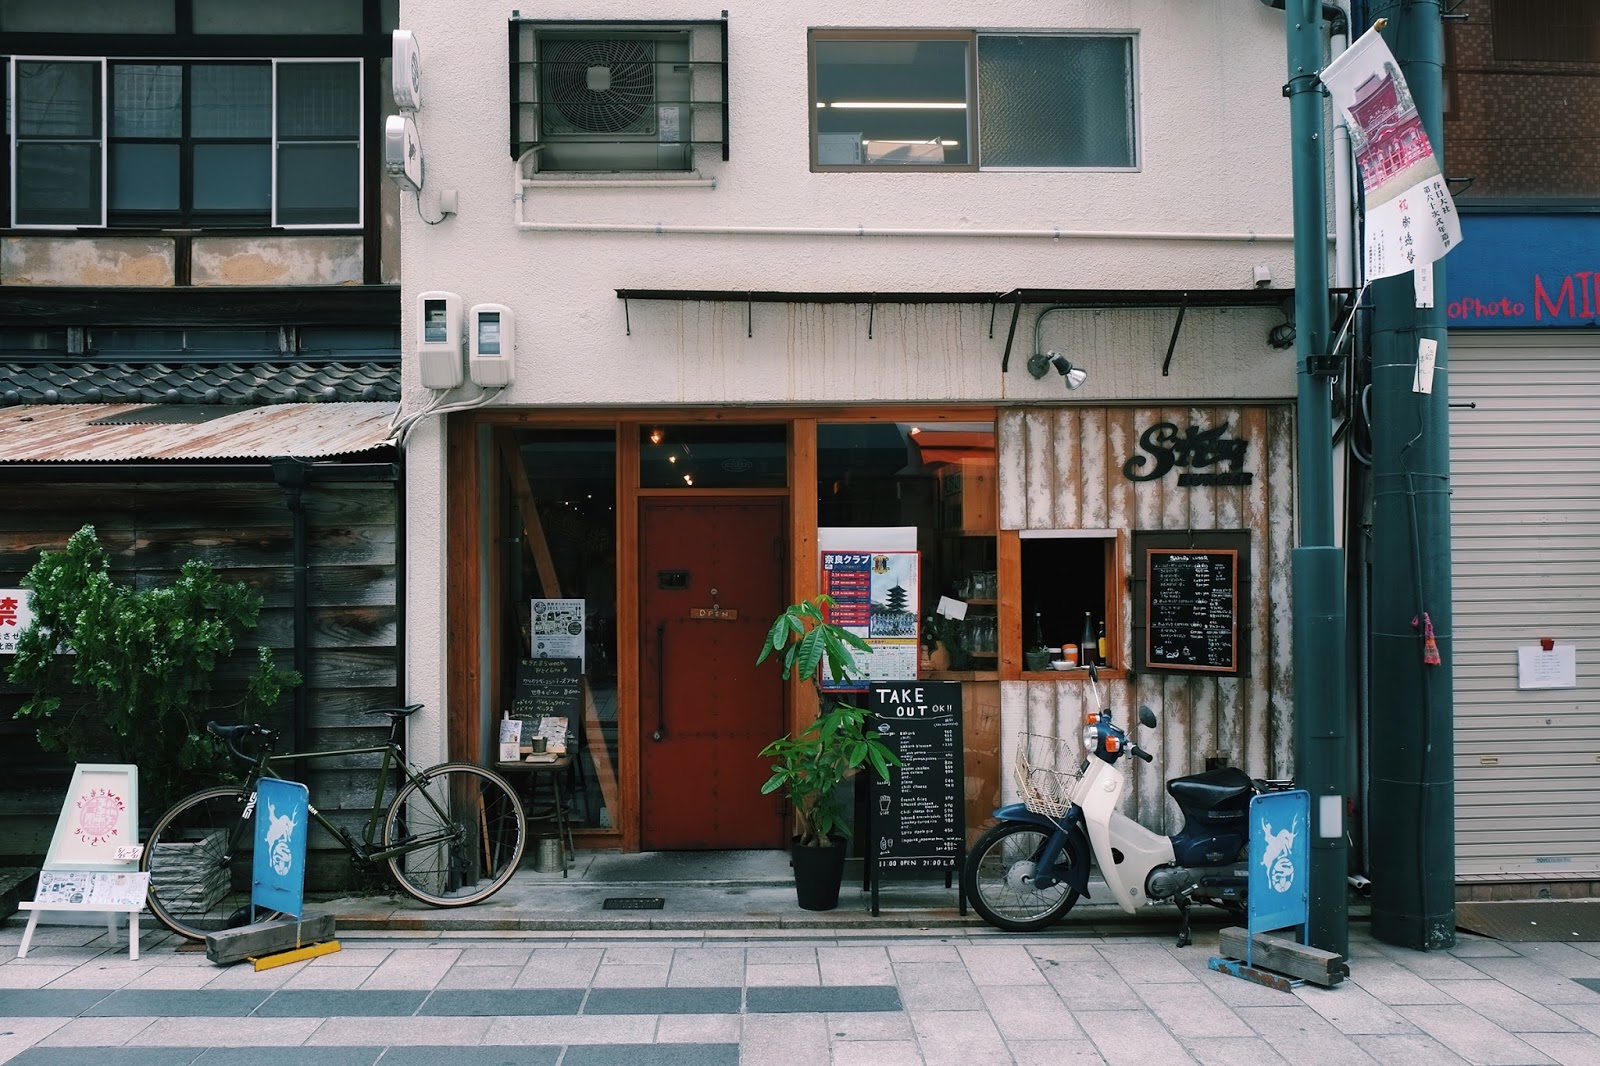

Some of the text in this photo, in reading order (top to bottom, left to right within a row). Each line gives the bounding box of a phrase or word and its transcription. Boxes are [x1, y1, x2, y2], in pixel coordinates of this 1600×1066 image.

[1433, 182, 1451, 214] 春日大社
[824, 554, 870, 564] 奈良クラブ
[876, 688, 924, 704] TAKE
[896, 706, 928, 716] OUT
